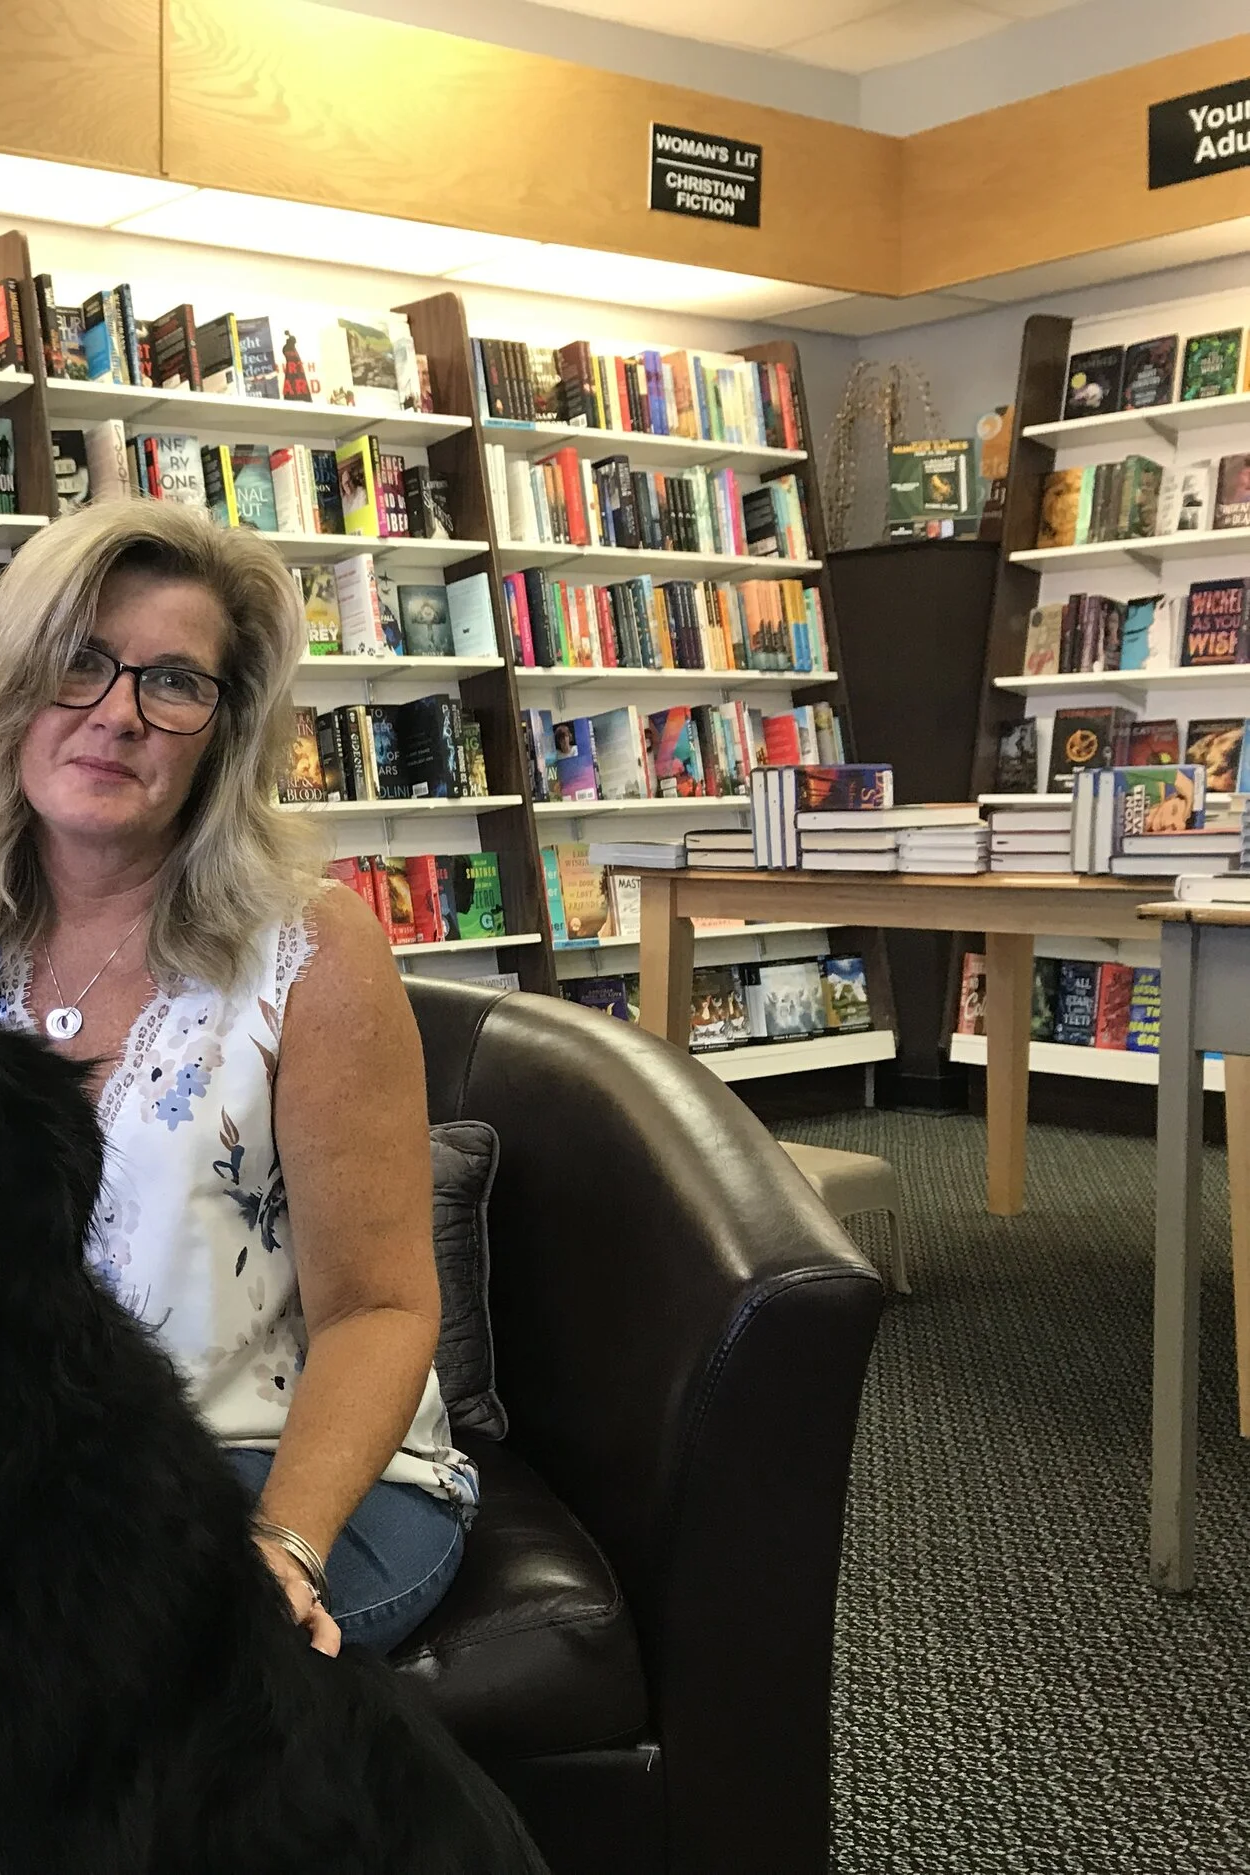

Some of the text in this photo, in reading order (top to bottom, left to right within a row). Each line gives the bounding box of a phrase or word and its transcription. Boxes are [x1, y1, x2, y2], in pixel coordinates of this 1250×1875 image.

[656, 133, 758, 168] WOMAN'S LIT
[666, 172, 746, 201] CHRISTIAN
[676, 192, 735, 217] FICTION
[170, 456, 189, 470] BY
[161, 474, 197, 490] ONE
[1191, 615, 1241, 631] AS YOU
[370, 708, 383, 718] TO
[351, 733, 363, 773] GIDEON
[386, 752, 400, 761] OF
[379, 766, 398, 776] ARS
[287, 789, 323, 801] BLOOD
[619, 879, 641, 889] MAST
[475, 889, 494, 909] ZERO
[1076, 977, 1092, 988] ALL
